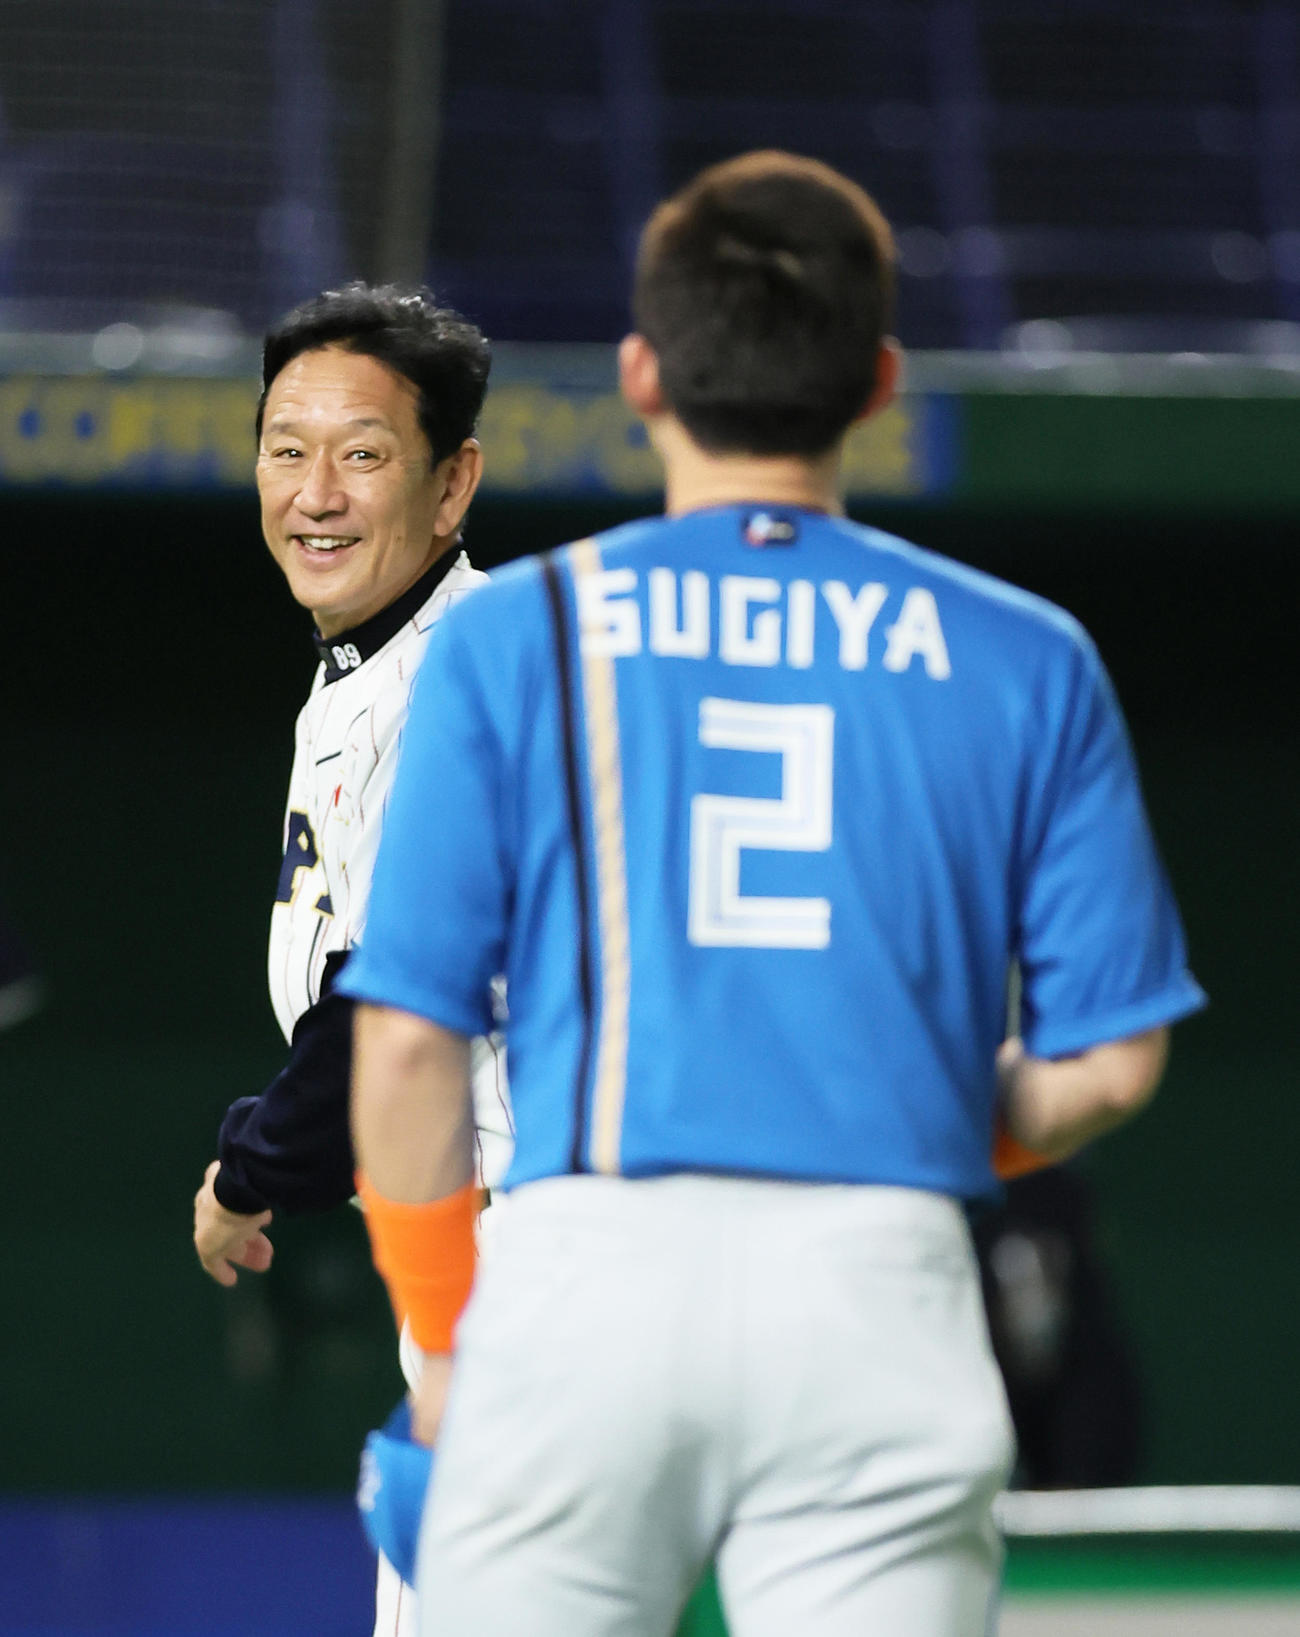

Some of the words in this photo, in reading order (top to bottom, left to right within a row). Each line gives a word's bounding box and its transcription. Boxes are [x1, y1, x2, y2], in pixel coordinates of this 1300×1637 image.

[331, 643, 362, 670] 89
[577, 567, 951, 680] SUGIYA
[687, 697, 834, 949] 2
